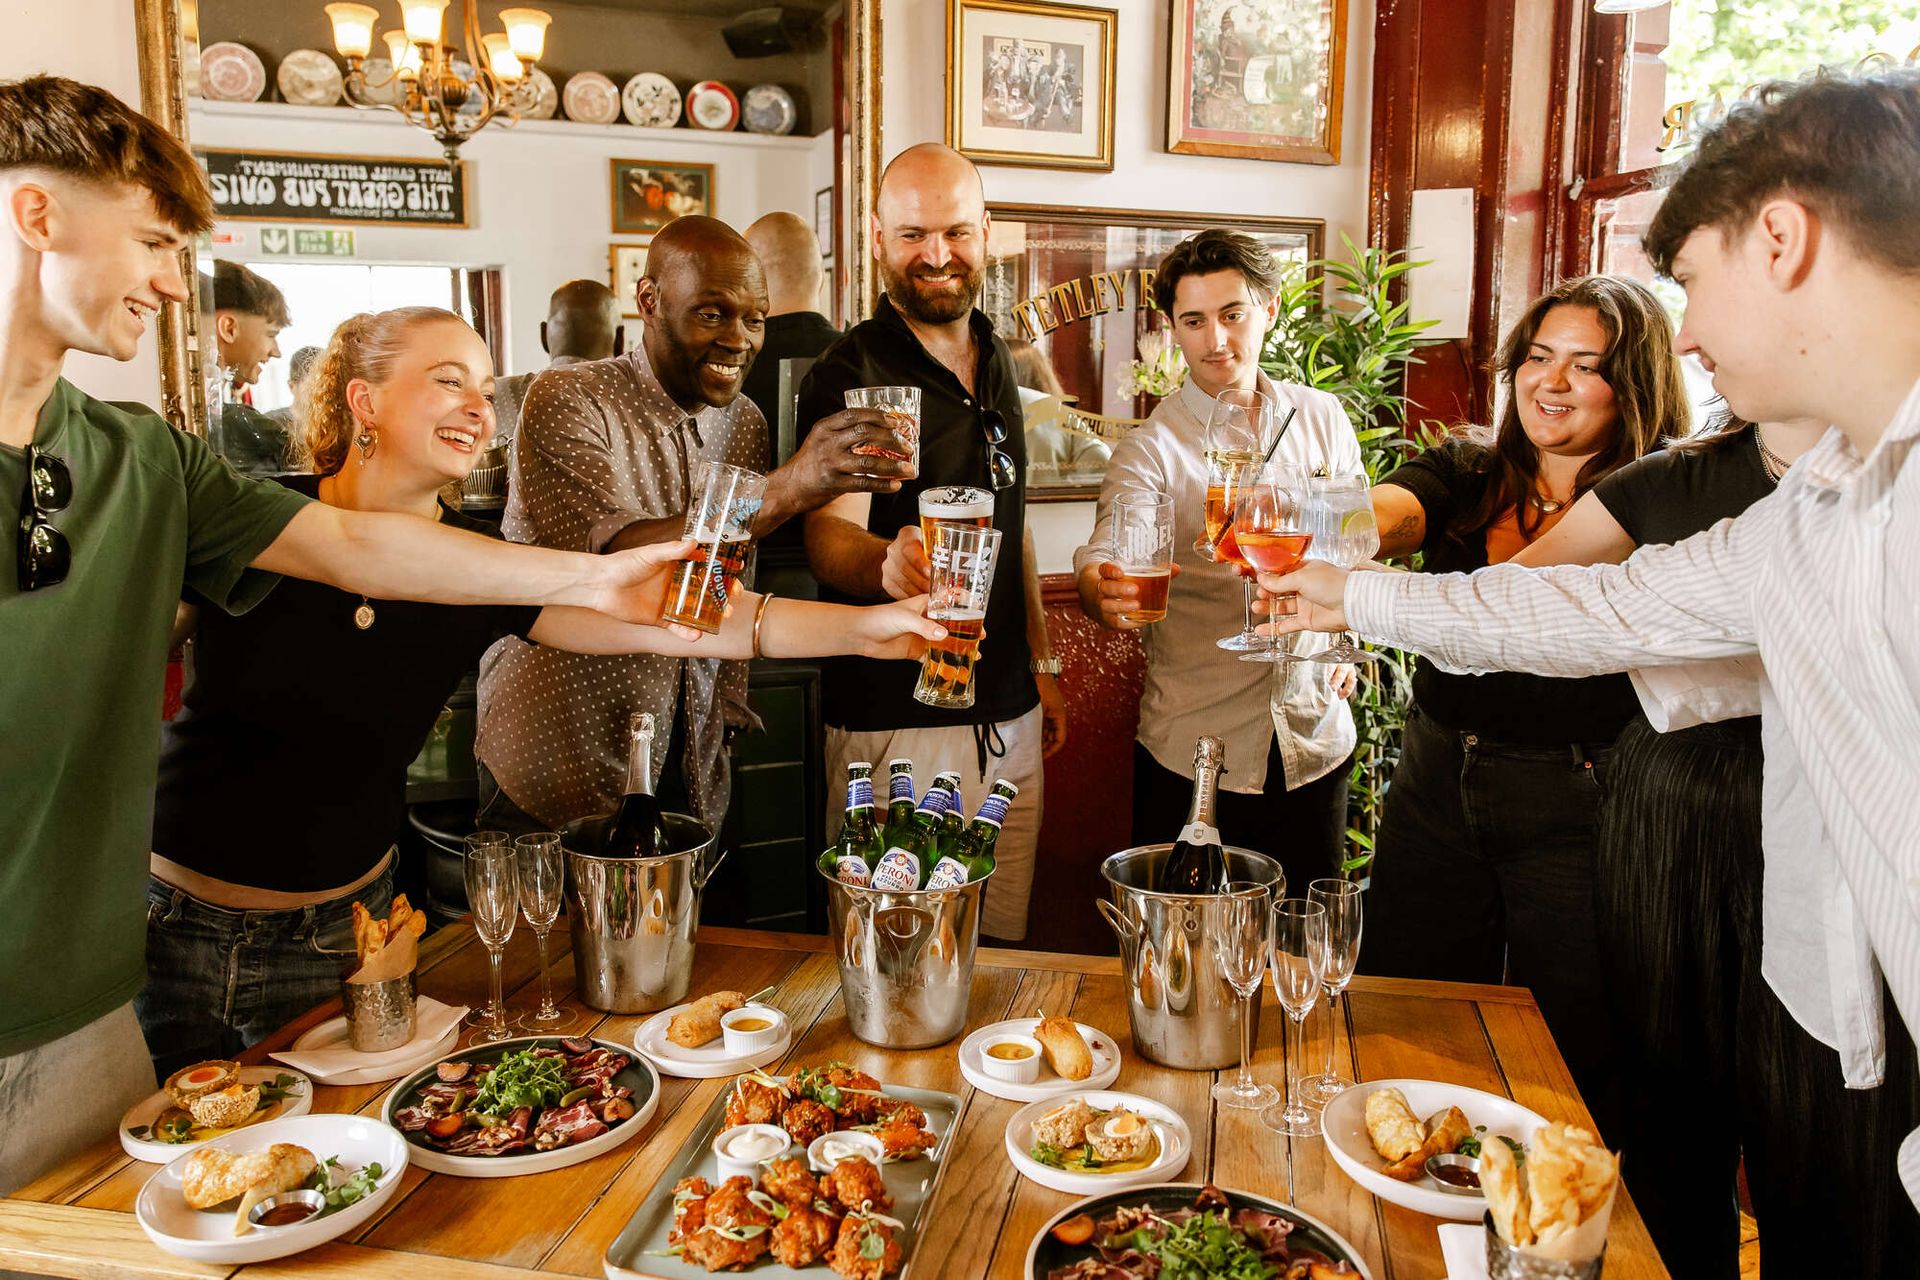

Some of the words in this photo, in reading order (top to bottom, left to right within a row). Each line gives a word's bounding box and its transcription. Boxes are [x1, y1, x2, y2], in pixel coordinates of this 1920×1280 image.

[1011, 269, 1132, 343] TETLEY
[1062, 411, 1114, 438] JOSHUA
[877, 862, 915, 887] PERONI
